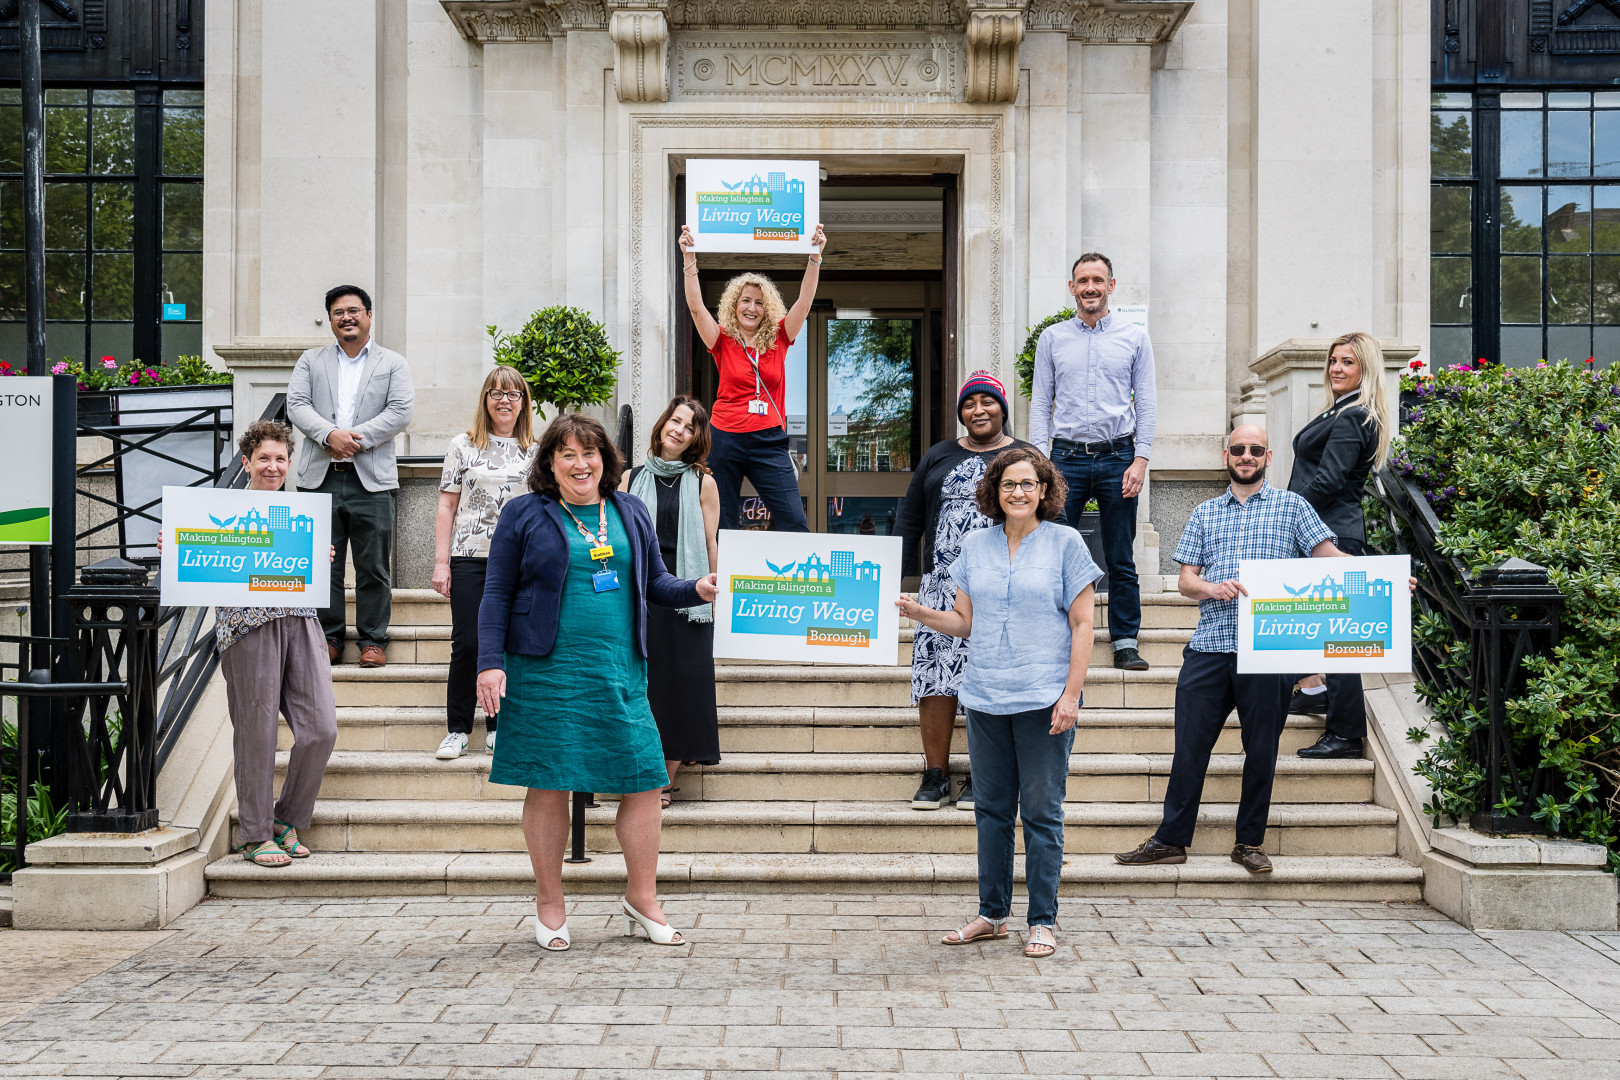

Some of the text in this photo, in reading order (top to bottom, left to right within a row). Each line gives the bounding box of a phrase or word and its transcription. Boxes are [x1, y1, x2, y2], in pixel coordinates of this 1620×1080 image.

[699, 195, 728, 204] Making
[730, 195, 764, 204] Islington
[701, 208, 802, 226] Living Wage
[755, 228, 797, 240] Borough
[0, 394, 41, 407] TON
[179, 532, 217, 544] Making
[220, 534, 262, 545] Islington
[181, 549, 310, 574] Living Wage
[251, 577, 303, 590] Borough
[734, 580, 832, 594] Making Islington a
[735, 598, 875, 626] Living Wage
[1254, 603, 1292, 613] Making
[1293, 602, 1338, 612] Islington
[1257, 617, 1388, 640] Living Wage
[809, 629, 867, 645] Borough
[1326, 643, 1382, 656] Borough
